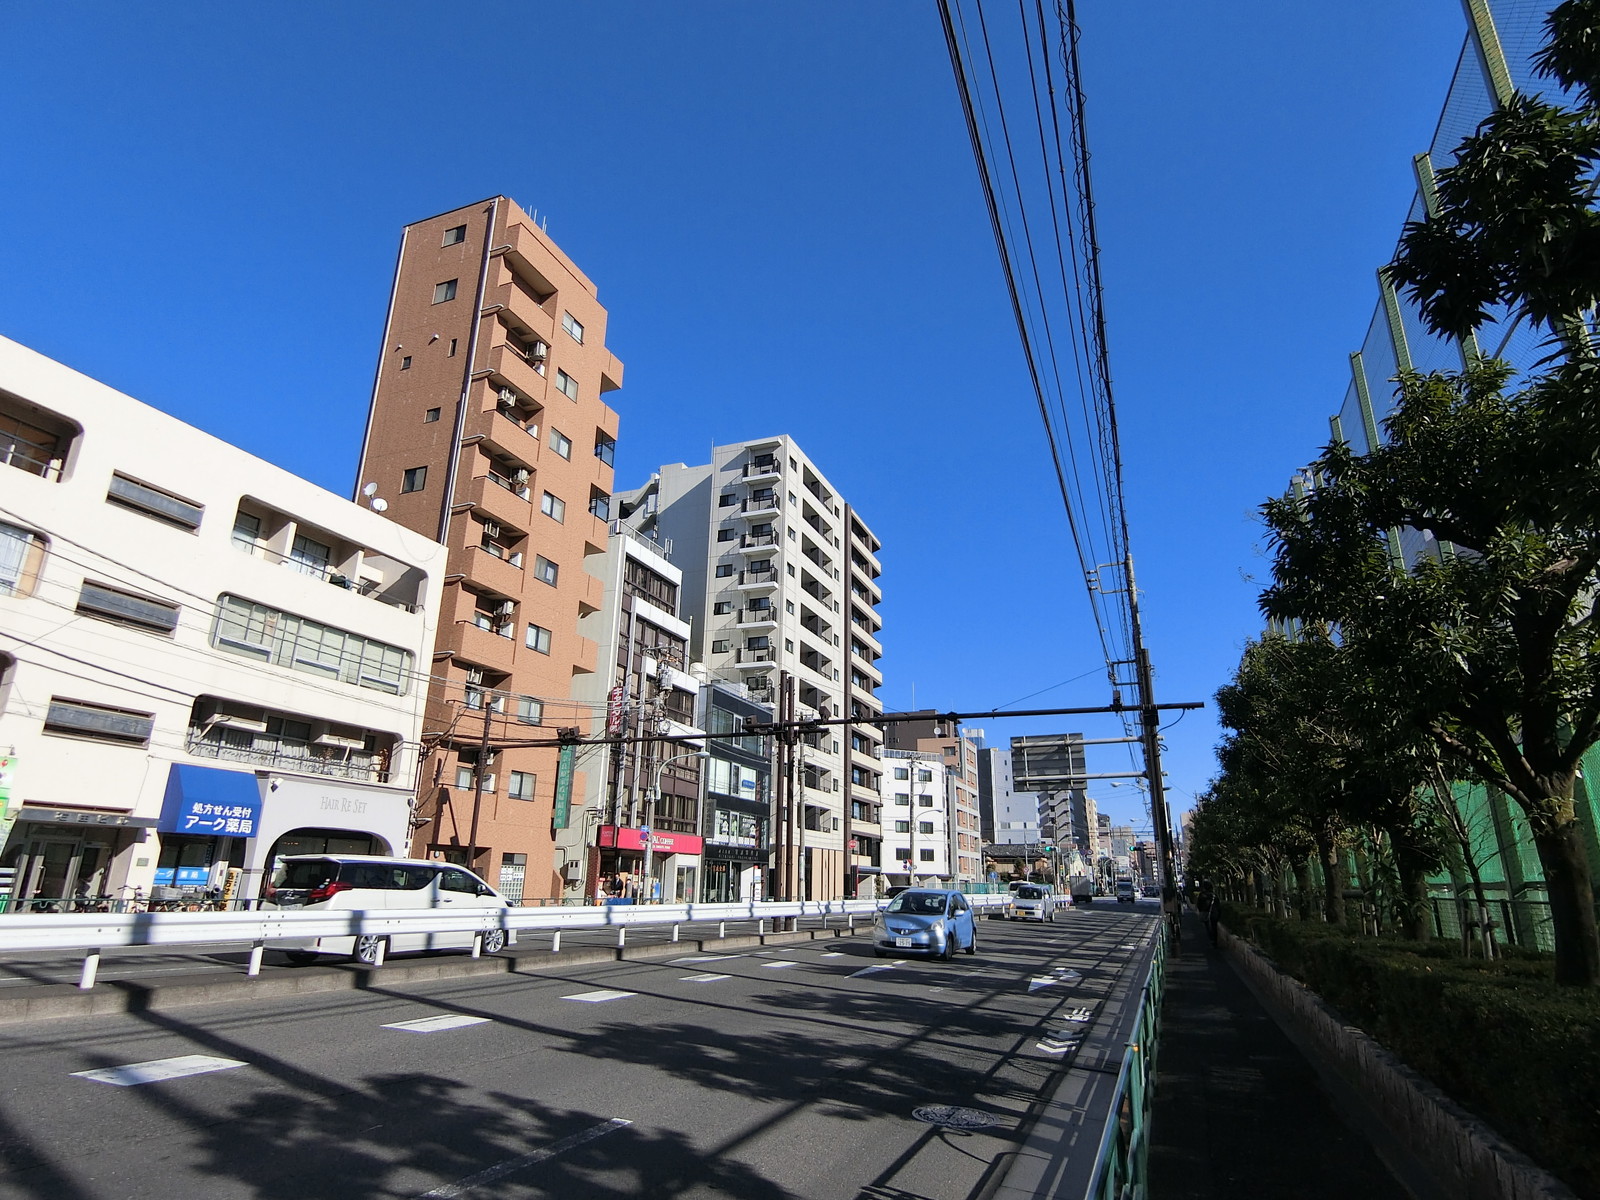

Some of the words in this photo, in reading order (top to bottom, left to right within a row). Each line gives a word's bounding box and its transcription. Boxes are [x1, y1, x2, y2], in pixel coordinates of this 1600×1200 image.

[192, 802, 252, 819] 処方せん受付
[185, 815, 253, 834] アーク薬局
